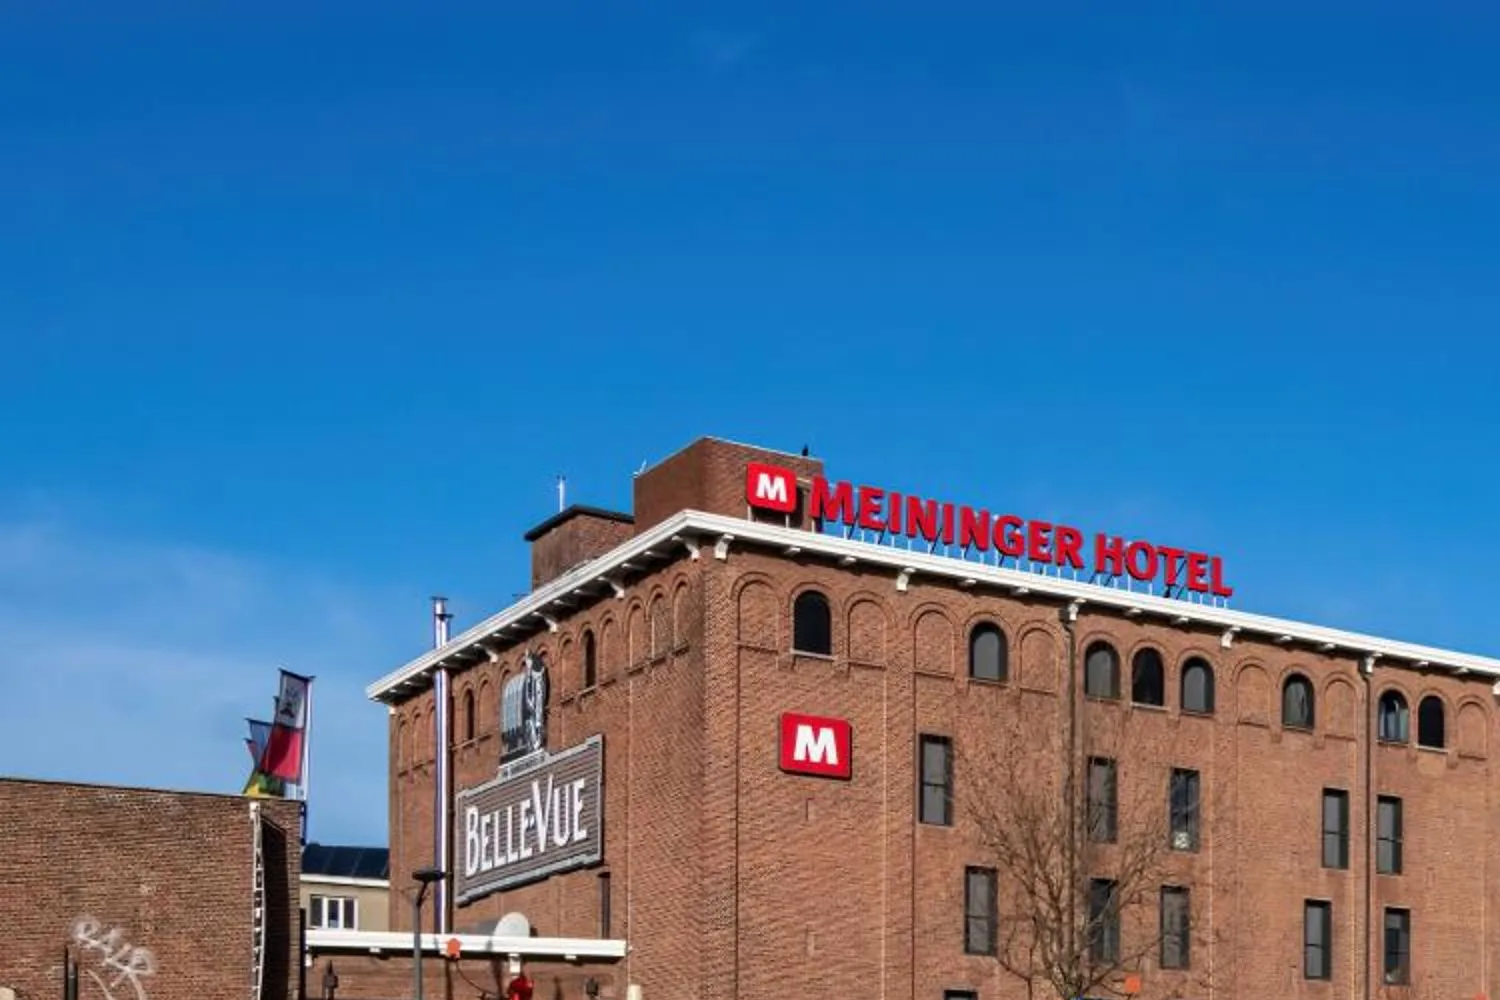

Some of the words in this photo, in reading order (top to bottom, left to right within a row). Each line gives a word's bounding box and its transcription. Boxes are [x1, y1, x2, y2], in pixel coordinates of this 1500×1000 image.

[756, 473, 788, 503] M
[809, 475, 1084, 570] MEININGER
[1094, 532, 1233, 597] HOTEL
[793, 724, 838, 766] M
